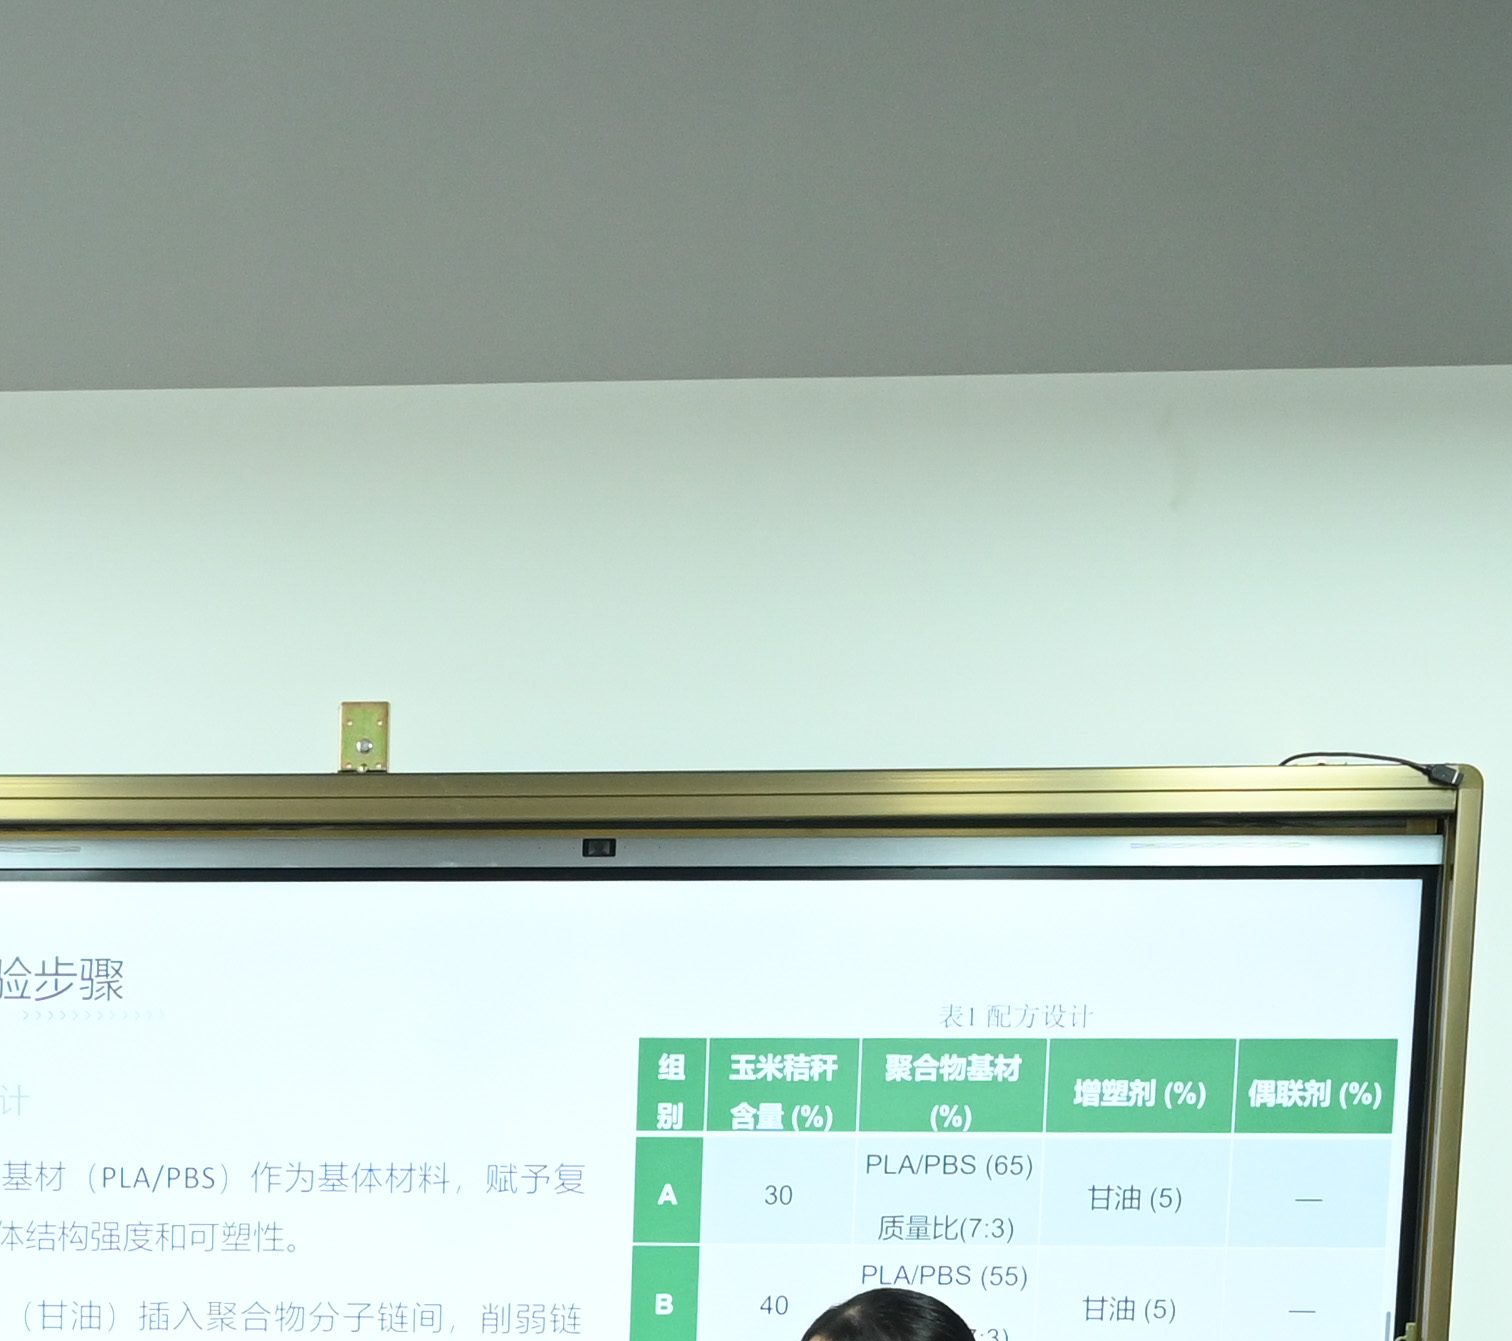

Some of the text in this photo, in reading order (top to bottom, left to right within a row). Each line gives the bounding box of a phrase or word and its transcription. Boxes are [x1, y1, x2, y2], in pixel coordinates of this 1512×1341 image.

[987, 1003, 1094, 1029] 配方设计
[657, 1052, 686, 1081] 组
[728, 1052, 839, 1082] 玉米秸秆
[885, 1053, 1023, 1082] 聚合物基材
[1073, 1078, 1207, 1110] 增塑剂 (%)
[1248, 1079, 1382, 1110] 偶联剂 (%)
[656, 1102, 684, 1130] 别
[730, 1102, 834, 1132] 含量 (%)
[929, 1104, 973, 1132] (%)
[866, 1154, 1033, 1181] PLA/PBS (65)
[657, 1183, 678, 1206] A
[764, 1184, 793, 1206] 30
[1087, 1184, 1182, 1214] 甘油 (5)
[877, 1214, 1014, 1244] 质量比(7:3)
[861, 1264, 1028, 1292] PLA/PBS (55)
[654, 1292, 674, 1316] B
[759, 1295, 789, 1316] 40
[1082, 1295, 1176, 1325] 甘油 (5)
